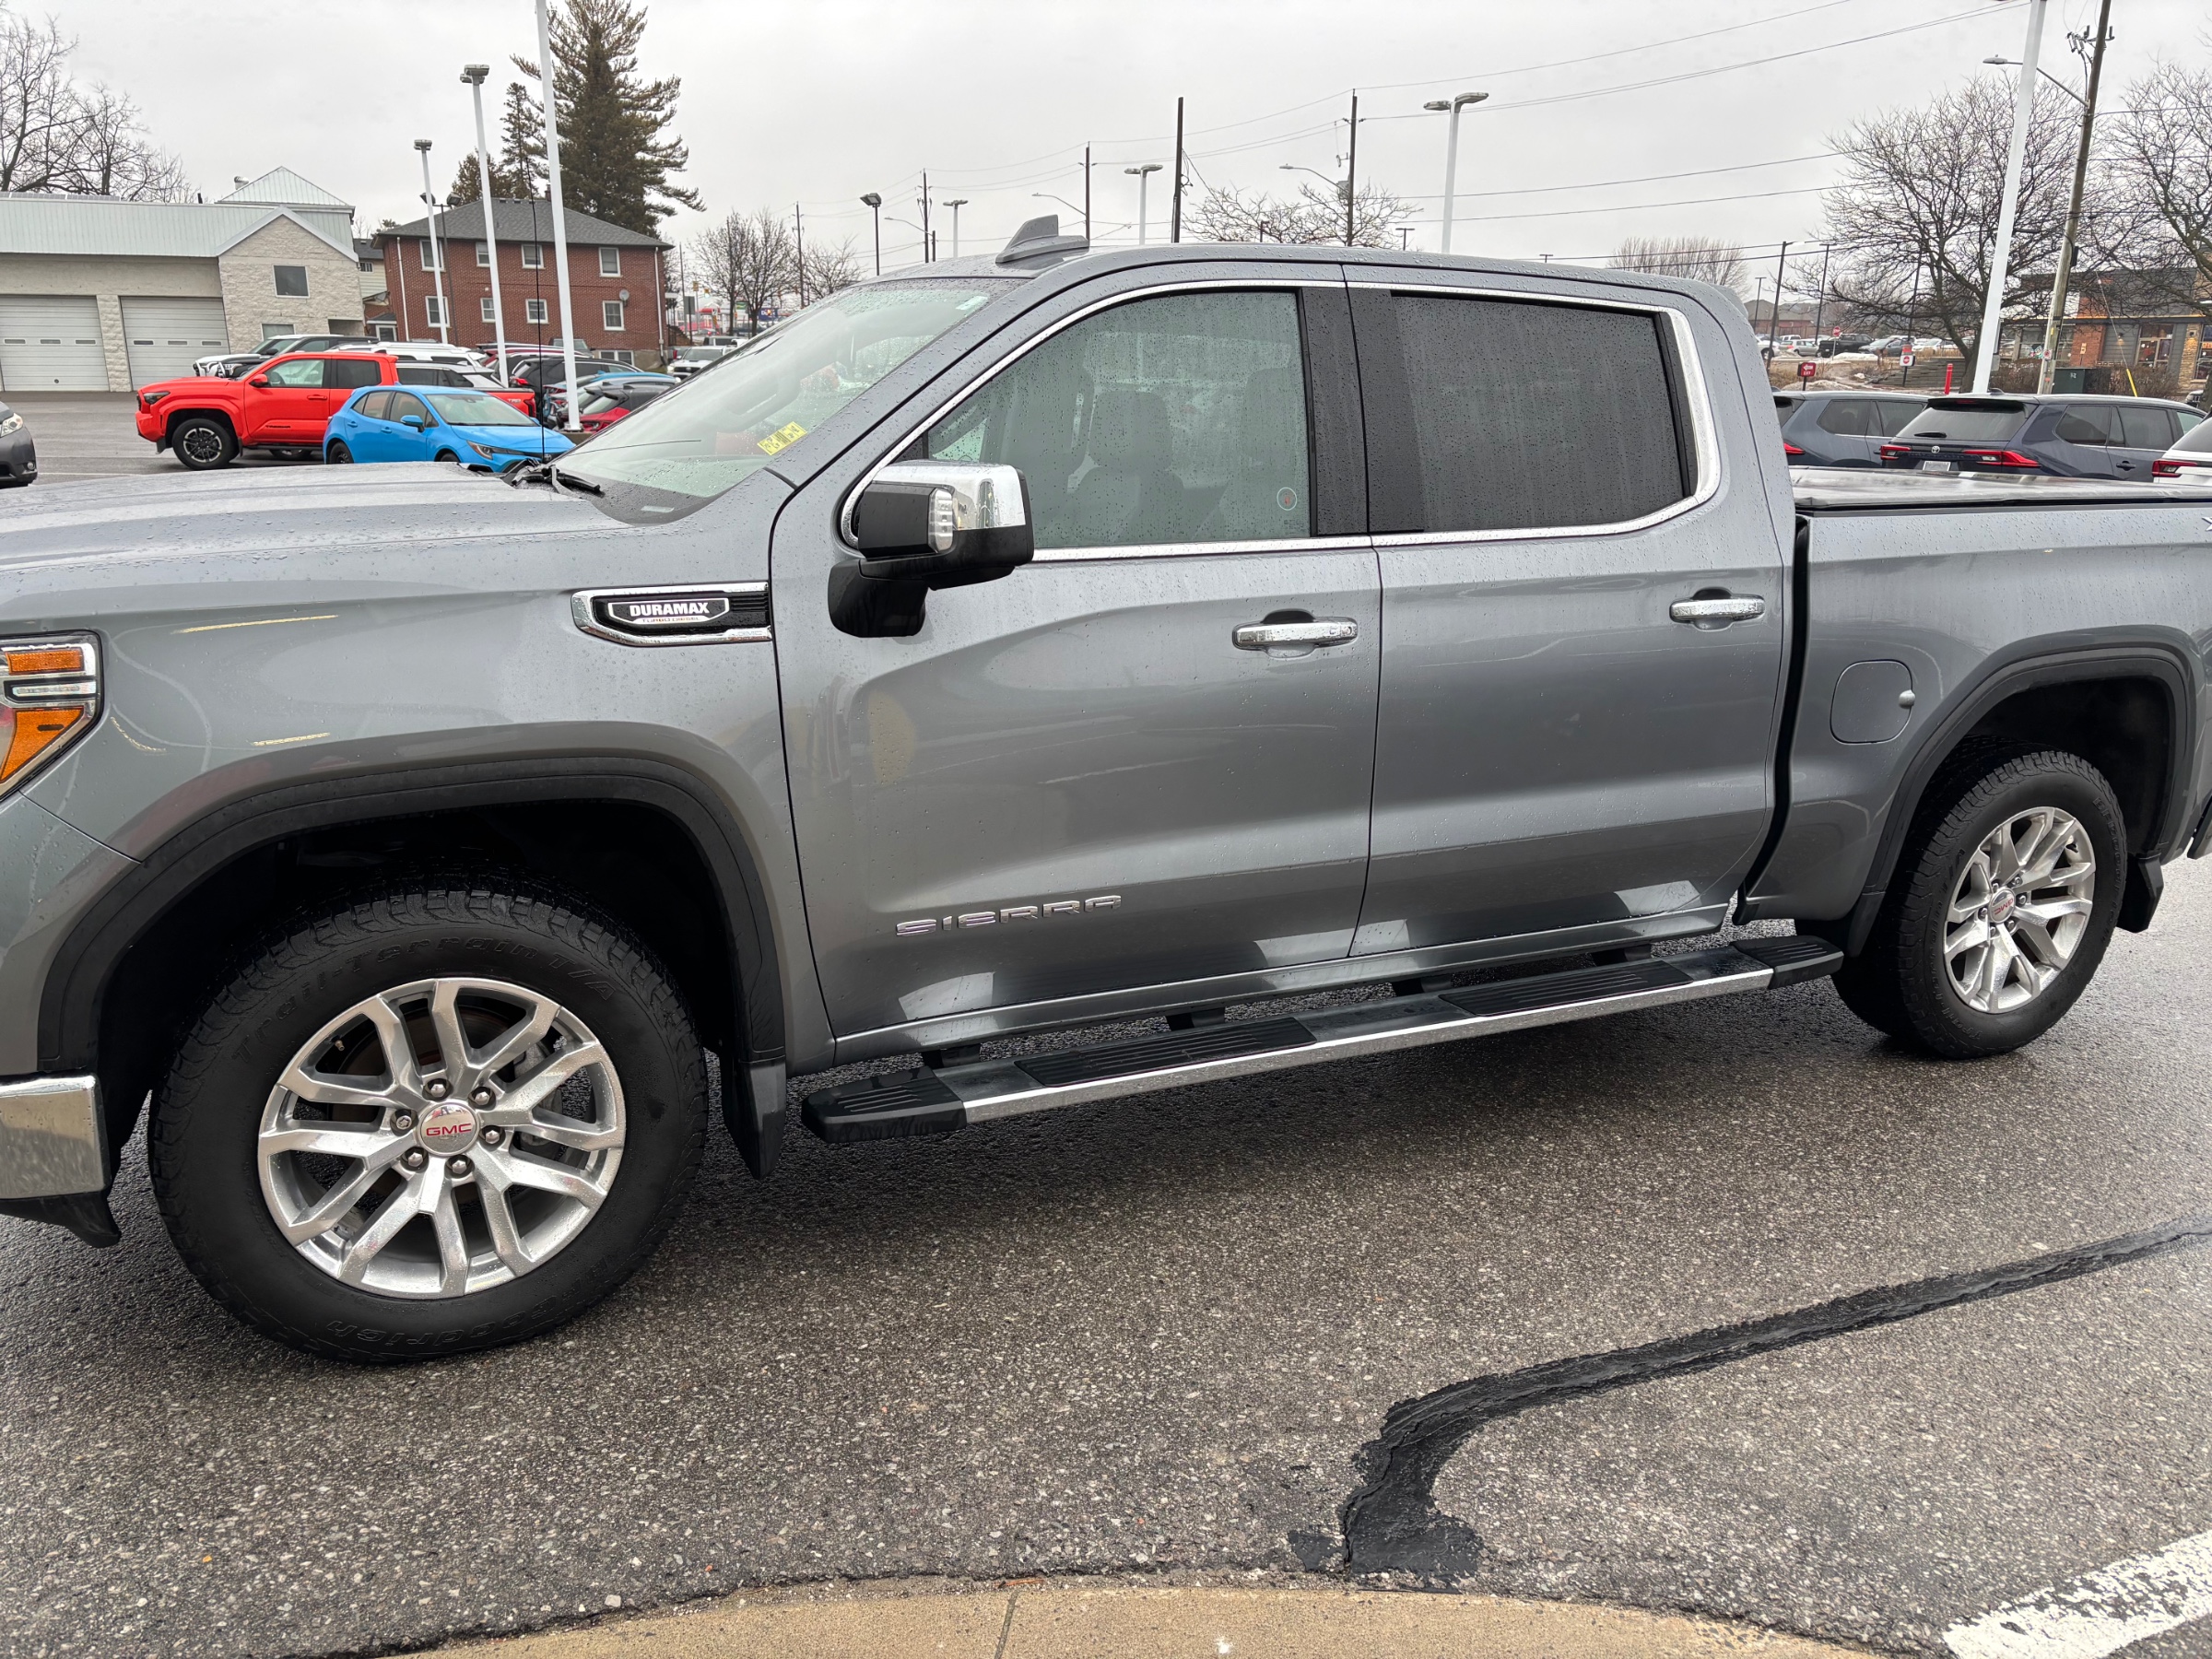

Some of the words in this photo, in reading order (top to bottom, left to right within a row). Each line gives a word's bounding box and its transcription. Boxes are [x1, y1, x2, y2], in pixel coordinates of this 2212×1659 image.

[629, 602, 710, 618] DURAMAX
[1994, 898, 2014, 915] GMC
[896, 894, 1122, 936] SIERRA
[426, 1123, 472, 1136] GMC
